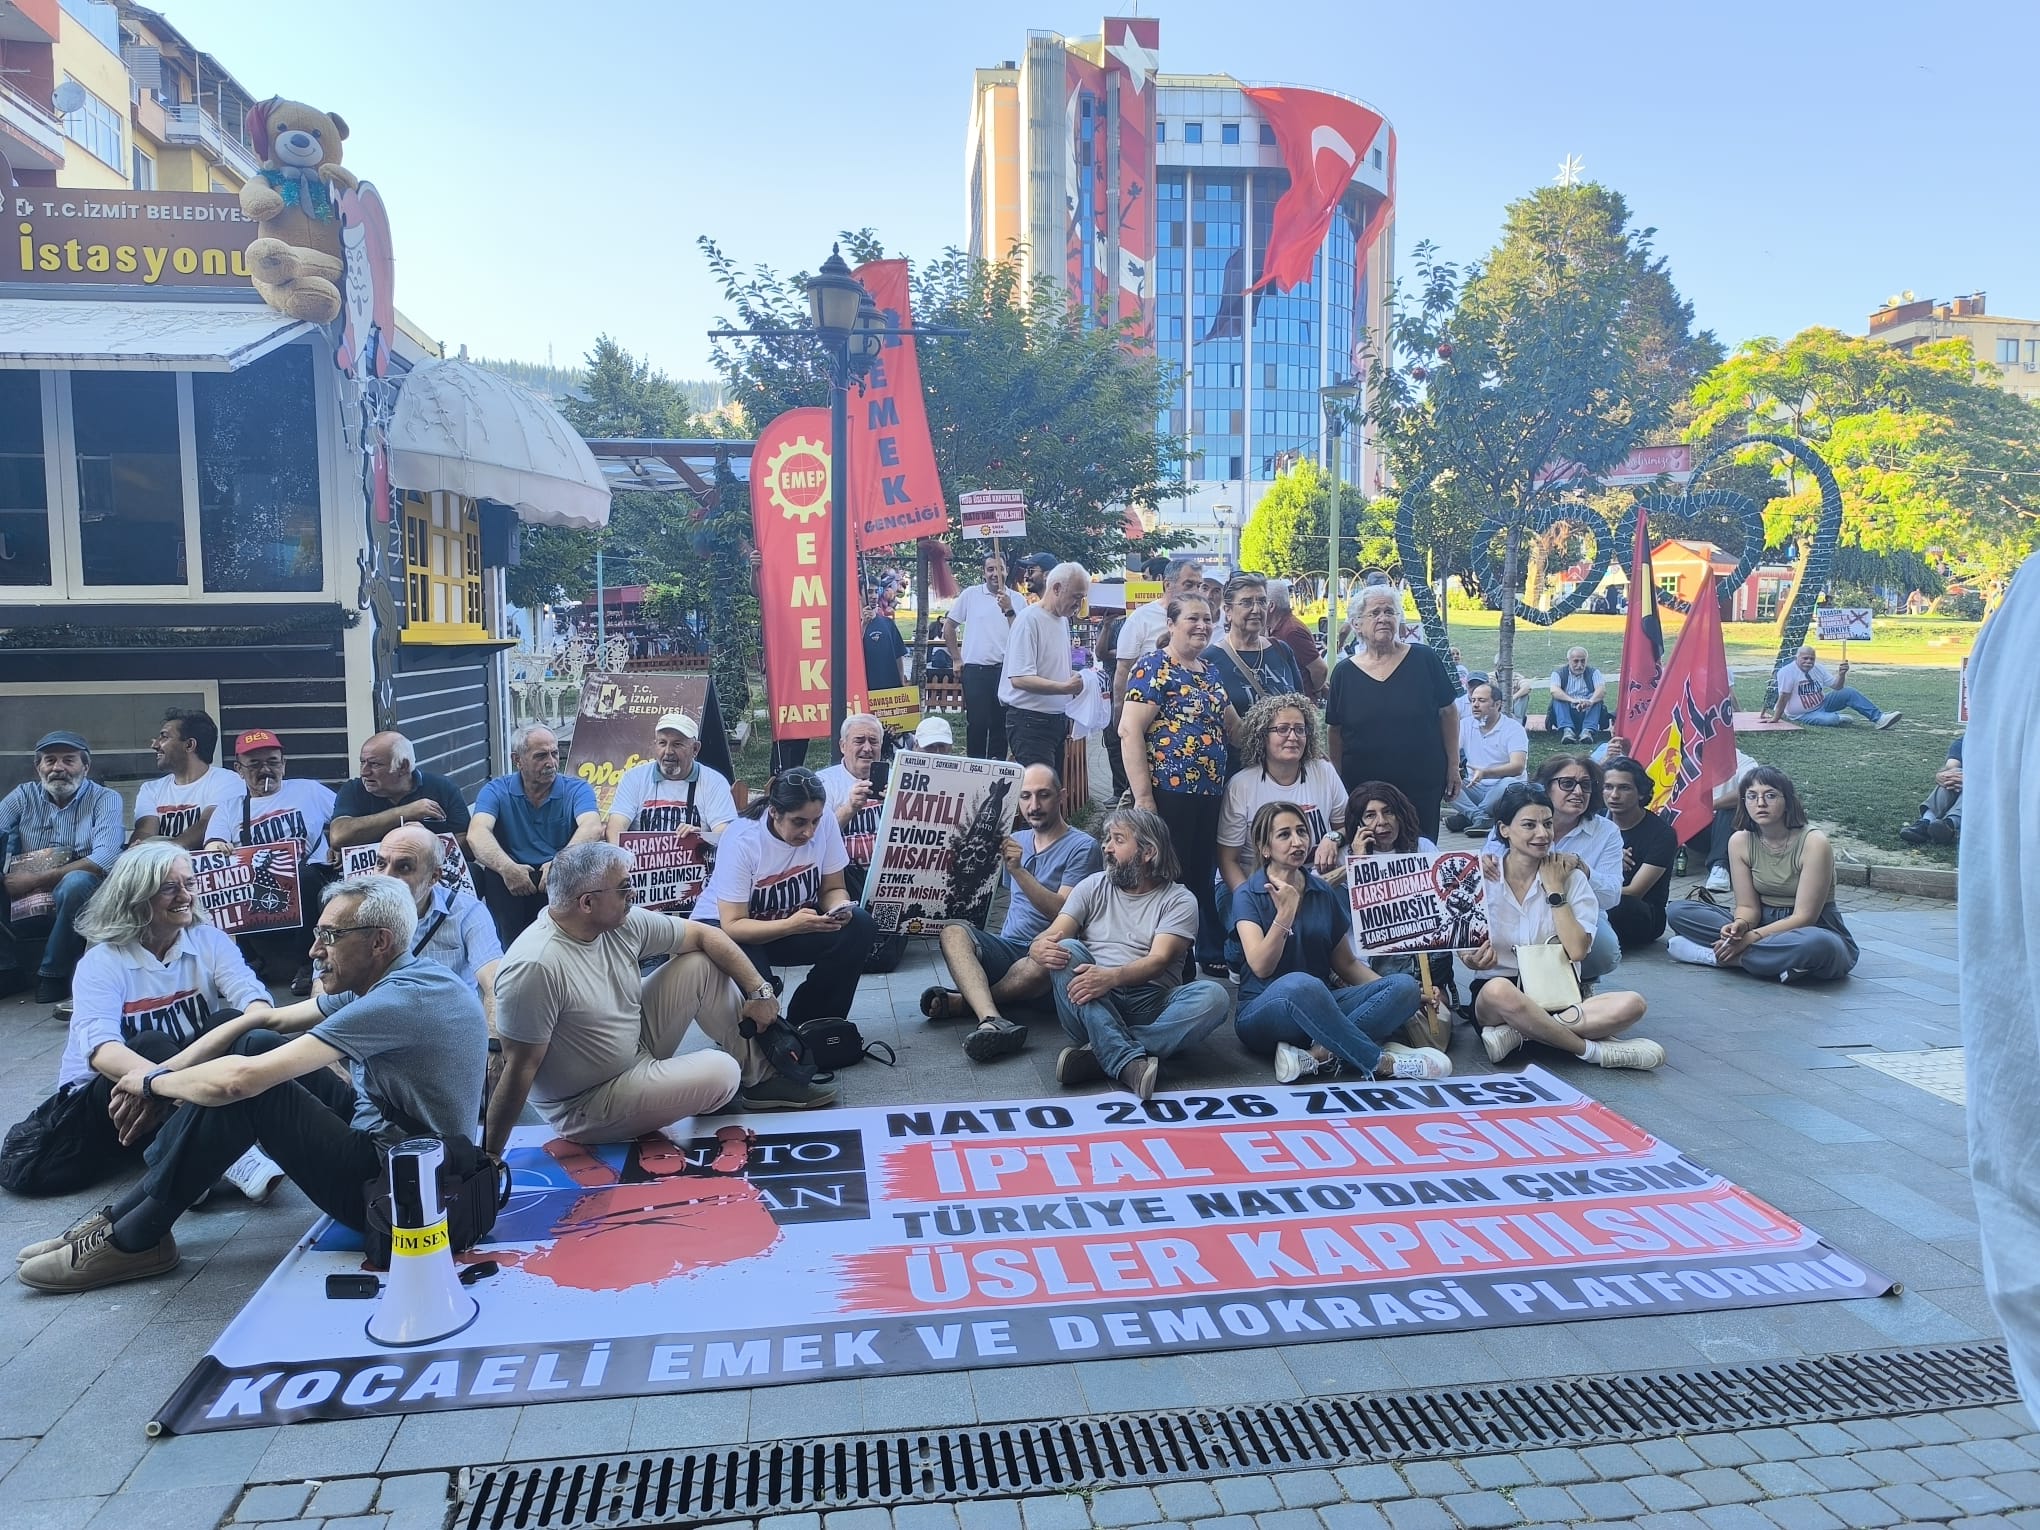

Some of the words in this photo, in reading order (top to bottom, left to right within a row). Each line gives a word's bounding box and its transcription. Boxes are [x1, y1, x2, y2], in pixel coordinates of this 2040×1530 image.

[781, 470, 826, 490] EMEP
[864, 503, 940, 533] GENÇLİĞİ
[790, 533, 830, 691] EMEK
[630, 693, 659, 704] İZMİT
[632, 685, 652, 693] T.C.
[628, 704, 684, 715] BELEDİYESİ
[869, 698, 894, 708] SAVAŞA
[905, 756, 927, 766] KATLİAM
[935, 759, 959, 770] SOYKIRIM
[969, 763, 983, 774] İŞGAL
[998, 767, 1015, 777] YAĞMA
[900, 770, 931, 792] BİR
[893, 791, 965, 825] KATİLİ
[888, 825, 947, 846] EVİNDE
[351, 849, 377, 872] ABD
[630, 850, 693, 872] ALTANATSIZ
[882, 846, 954, 873] MİSAFİR
[1354, 861, 1379, 886] ABD
[1387, 856, 1430, 878] NATO'YA
[213, 865, 251, 890] NATO
[630, 873, 647, 889] AM
[651, 865, 702, 886] BAĞIMSIZ
[879, 873, 915, 884] ETMEK
[1356, 885, 1389, 906] KARŞI
[1388, 871, 1434, 898] DURMAK
[649, 884, 677, 903] ÜLKE
[875, 884, 905, 898] İSTER
[907, 885, 947, 900] MİSİN?
[1360, 894, 1440, 931] MONARŞİYE
[1365, 930, 1389, 944] KARŞI
[886, 1105, 1075, 1138] NATO
[1096, 1093, 1279, 1126] 2026
[1291, 1076, 1563, 1116] ZİRVESİ
[929, 1136, 1215, 1194] İPTAL
[1219, 1112, 1631, 1174] EDİLSİN!
[893, 1195, 1176, 1239] TÜRKİYE
[1187, 1176, 1501, 1220] NATO'DAN
[904, 1237, 1220, 1303] ÜSLER
[1226, 1196, 1796, 1281] KAPATILSIN!
[205, 1342, 613, 1419] KOCAELİ
[647, 1328, 886, 1383] EMEK
[915, 1320, 1018, 1360] VE
[1048, 1279, 1489, 1351] DEMOKRASİ
[1498, 1253, 1867, 1315] PLATFORMU
